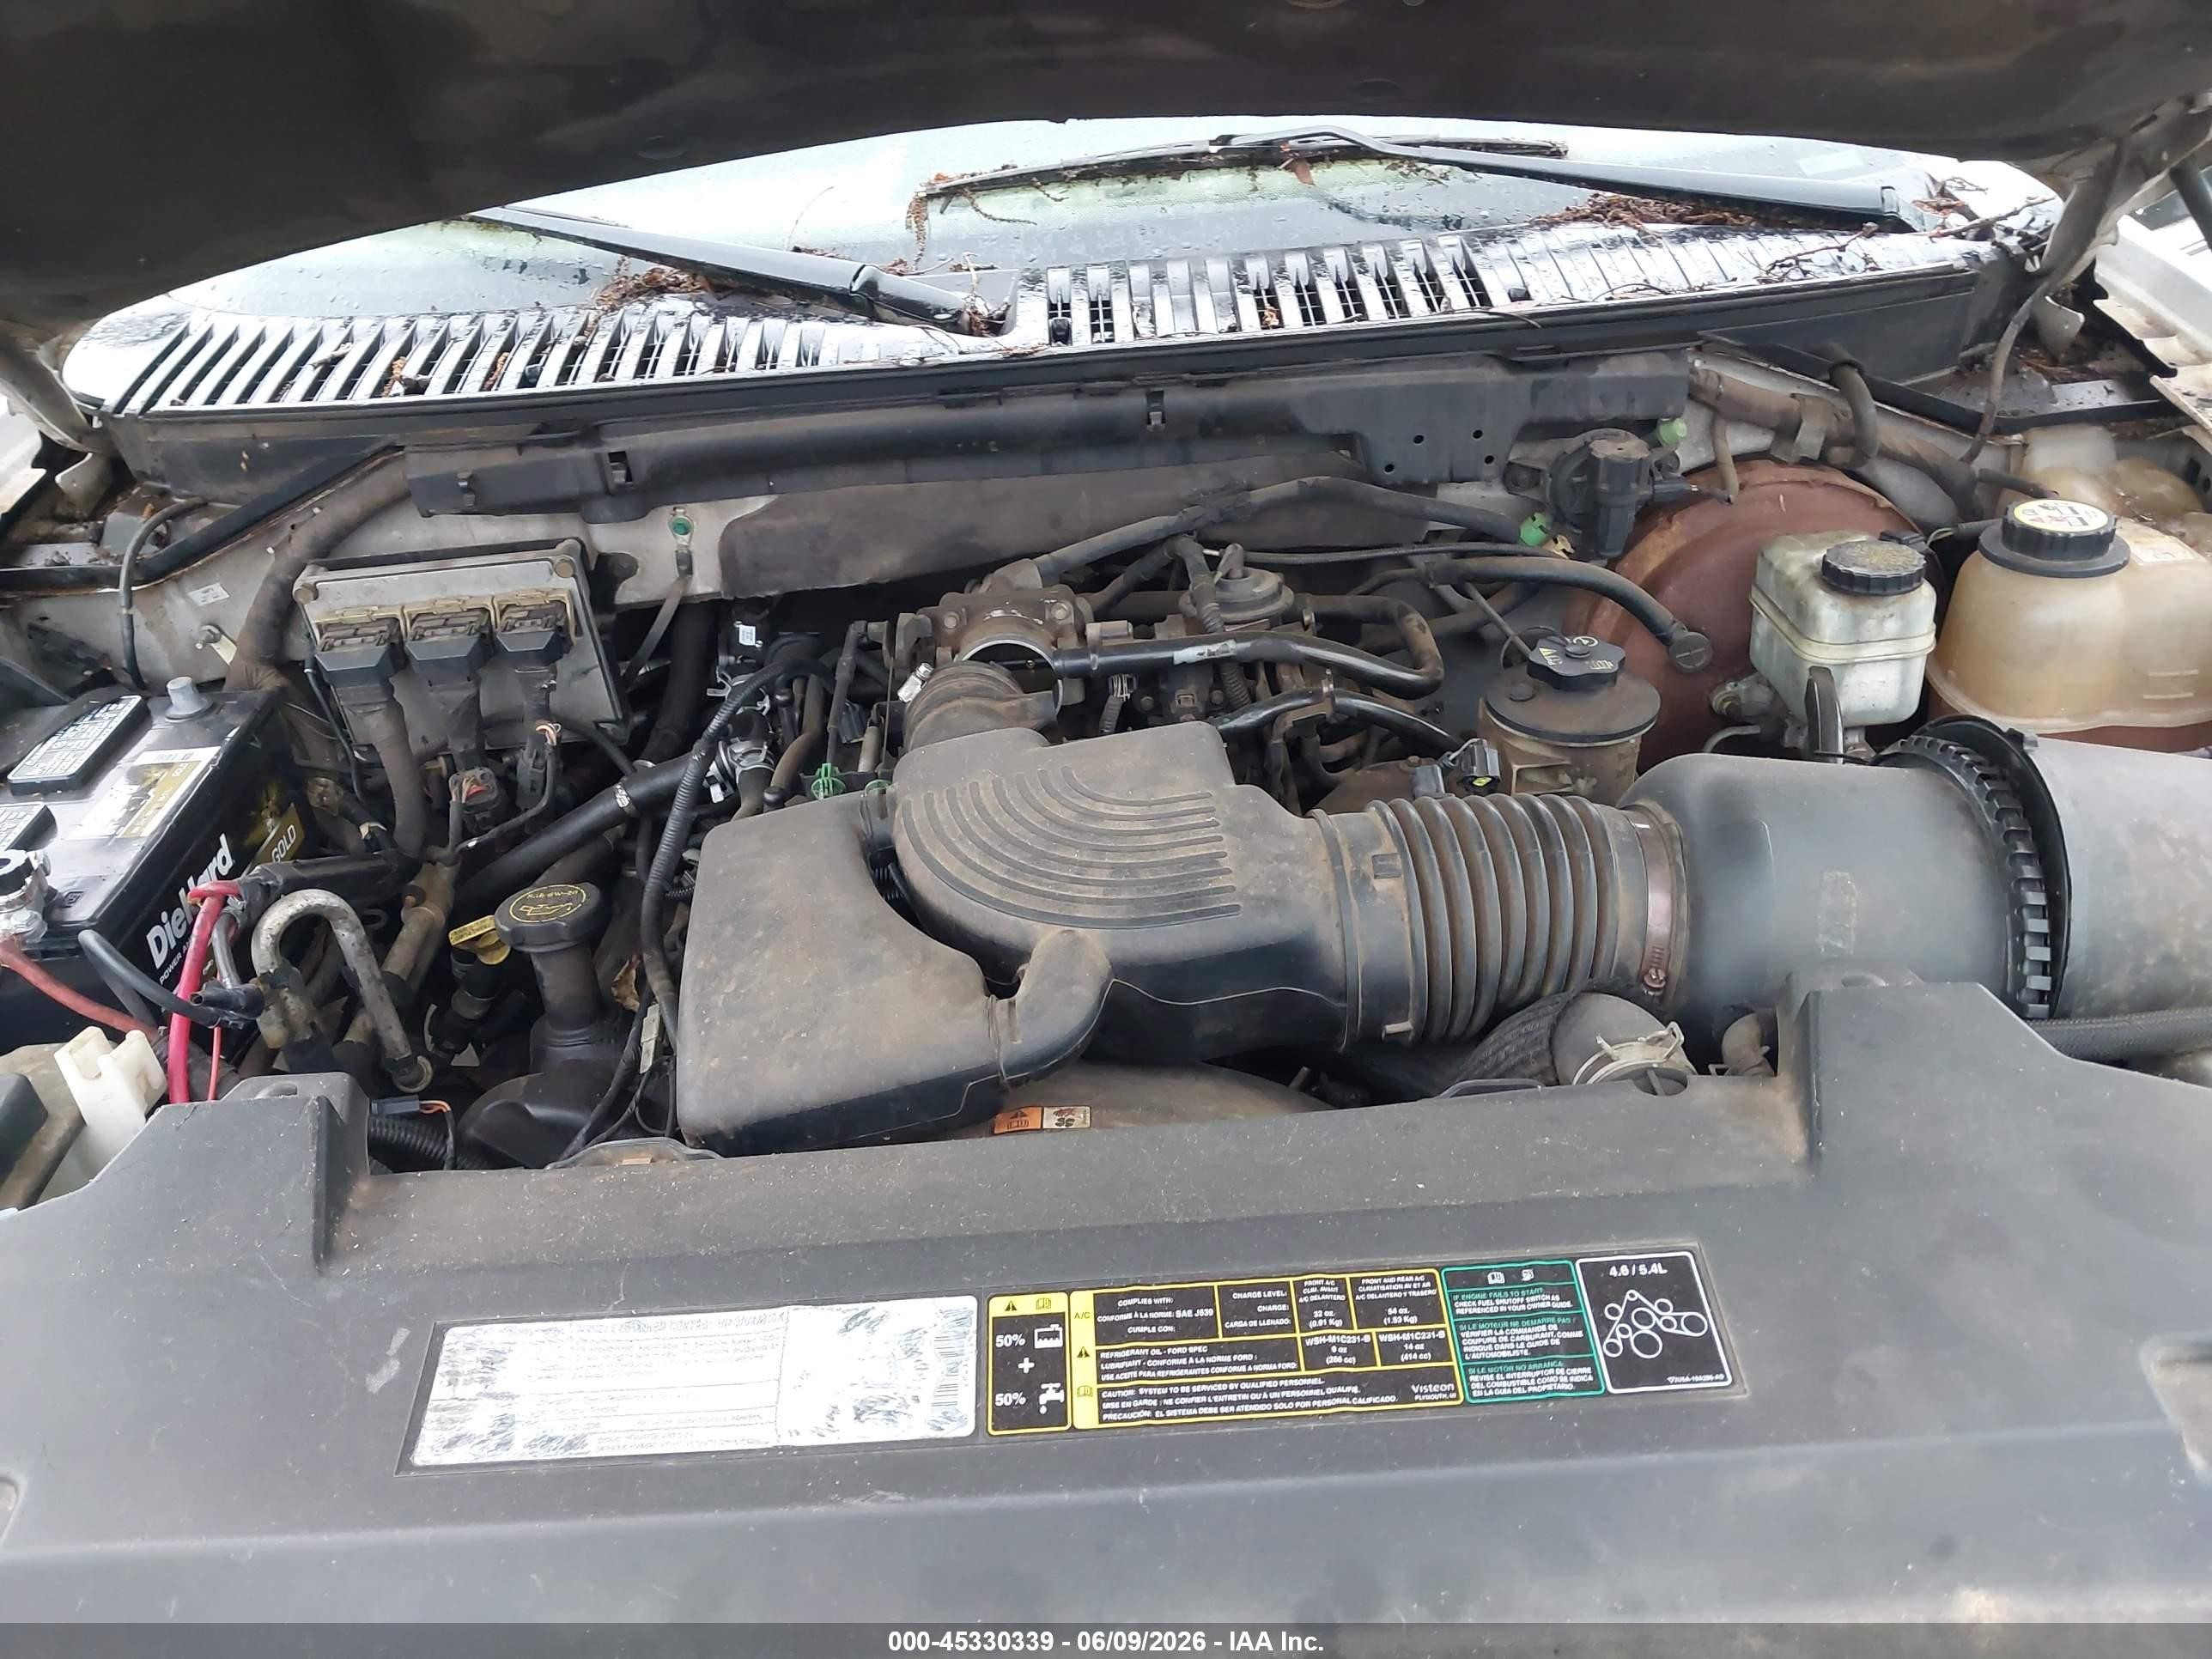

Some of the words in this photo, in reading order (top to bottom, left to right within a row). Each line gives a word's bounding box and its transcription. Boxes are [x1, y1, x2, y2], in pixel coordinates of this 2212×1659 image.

[271, 825, 296, 863] GOLD
[160, 951, 183, 985] POWER
[1609, 1265, 1630, 1278] 4.6
[1638, 1262, 1668, 1275] 5.4L
[1263, 1290, 1287, 1298] LEVEL:
[1117, 1297, 1152, 1307] COMPLIES
[1194, 1308, 1214, 1317] J639
[995, 1334, 1026, 1347] 50%
[1100, 1348, 1149, 1359] REFRIGERANT
[1100, 1359, 1142, 1370] LUBRIFIANT
[1191, 1383, 1228, 1393] SERVICED
[1239, 1380, 1278, 1389] QUALIFIED
[1411, 1382, 1455, 1394] Visteon
[994, 1392, 1026, 1407] 50%
[1312, 1397, 1351, 1407] PERSONAL
